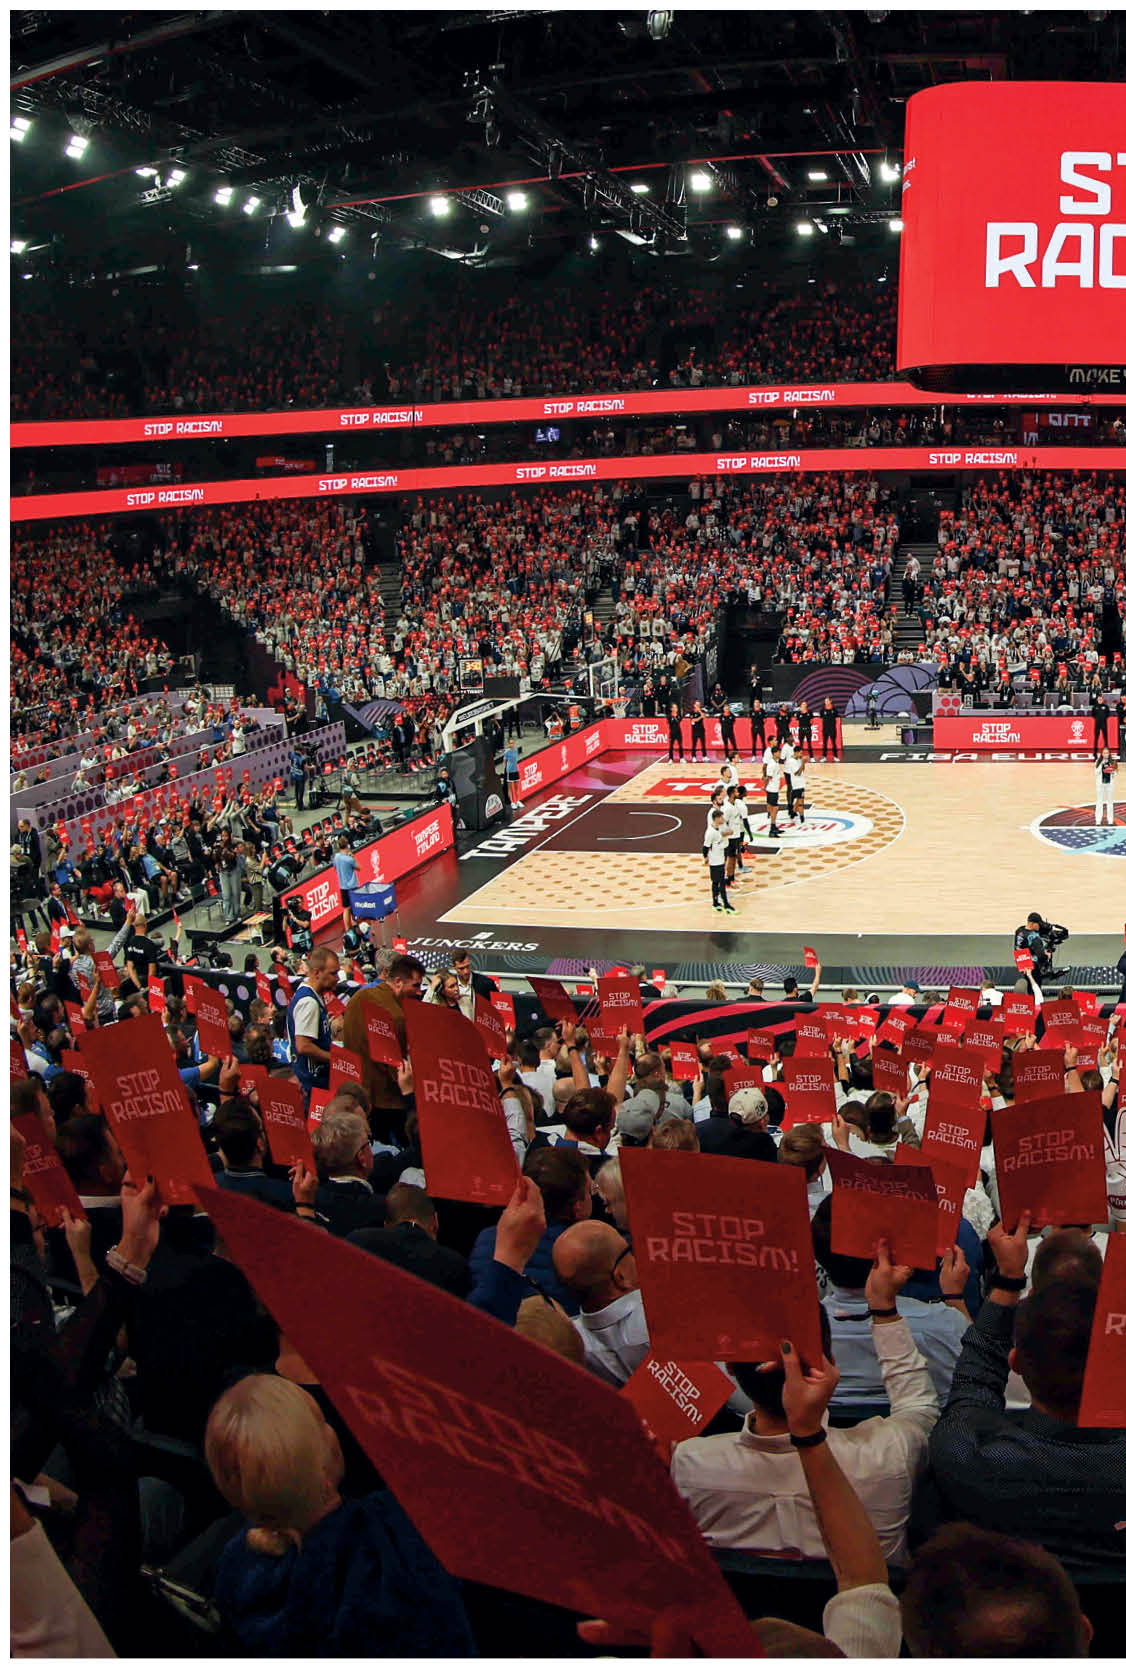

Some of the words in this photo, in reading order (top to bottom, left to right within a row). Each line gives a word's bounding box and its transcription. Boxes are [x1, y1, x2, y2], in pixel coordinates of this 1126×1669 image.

[748, 390, 779, 404] STOP
[784, 389, 835, 402] RACISM!
[543, 400, 574, 413] STOP
[577, 398, 625, 412] RACISM!
[340, 411, 368, 425] STOP
[373, 409, 423, 424] RACISM!
[144, 422, 173, 435] STOP
[176, 420, 223, 434] RACISM!
[716, 457, 748, 470] STOP
[751, 455, 801, 469] RACISM!
[929, 452, 961, 465] STOP
[964, 452, 1017, 465] RACISM!
[515, 465, 547, 479] STOP
[550, 463, 597, 478] RACISM!
[318, 478, 348, 492] STOP
[351, 475, 398, 490] RACISM!
[127, 490, 154, 505] STOP
[158, 488, 204, 504] RACISM!
[632, 724, 659, 733] STOP
[982, 723, 1011, 733] STOP
[625, 733, 668, 743] RACISM!
[973, 733, 1021, 743] RACISM!
[879, 752, 979, 762] FIBA
[458, 794, 593, 860] TAMPERE
[306, 881, 329, 907] STOP
[407, 936, 539, 951] JUNCKERS
[602, 999, 638, 1008] RACISM!
[609, 992, 630, 1000] STOP
[966, 1038, 1000, 1049] RACISM!
[973, 1032, 993, 1041] STOP
[438, 1057, 489, 1089] STOP
[943, 1064, 972, 1075] STOP
[1024, 1065, 1051, 1074] STOP
[116, 1068, 161, 1097] STOP
[796, 1073, 822, 1084] STOP
[934, 1070, 979, 1087] RACISM!
[1016, 1073, 1060, 1083] RACISM!
[788, 1081, 831, 1092] RACISM!
[111, 1089, 184, 1123] RACISM!
[422, 1080, 503, 1117] RACIS
[270, 1101, 295, 1115] STOP
[939, 1122, 970, 1137] STOP
[927, 1131, 978, 1150] RACISM!
[1019, 1129, 1075, 1153] STOP
[1003, 1143, 1096, 1173] RACISM!
[672, 1210, 766, 1241] STOP
[646, 1236, 800, 1273] RACISM!
[663, 1360, 702, 1401] STOP
[646, 1359, 703, 1425] RACISM!
